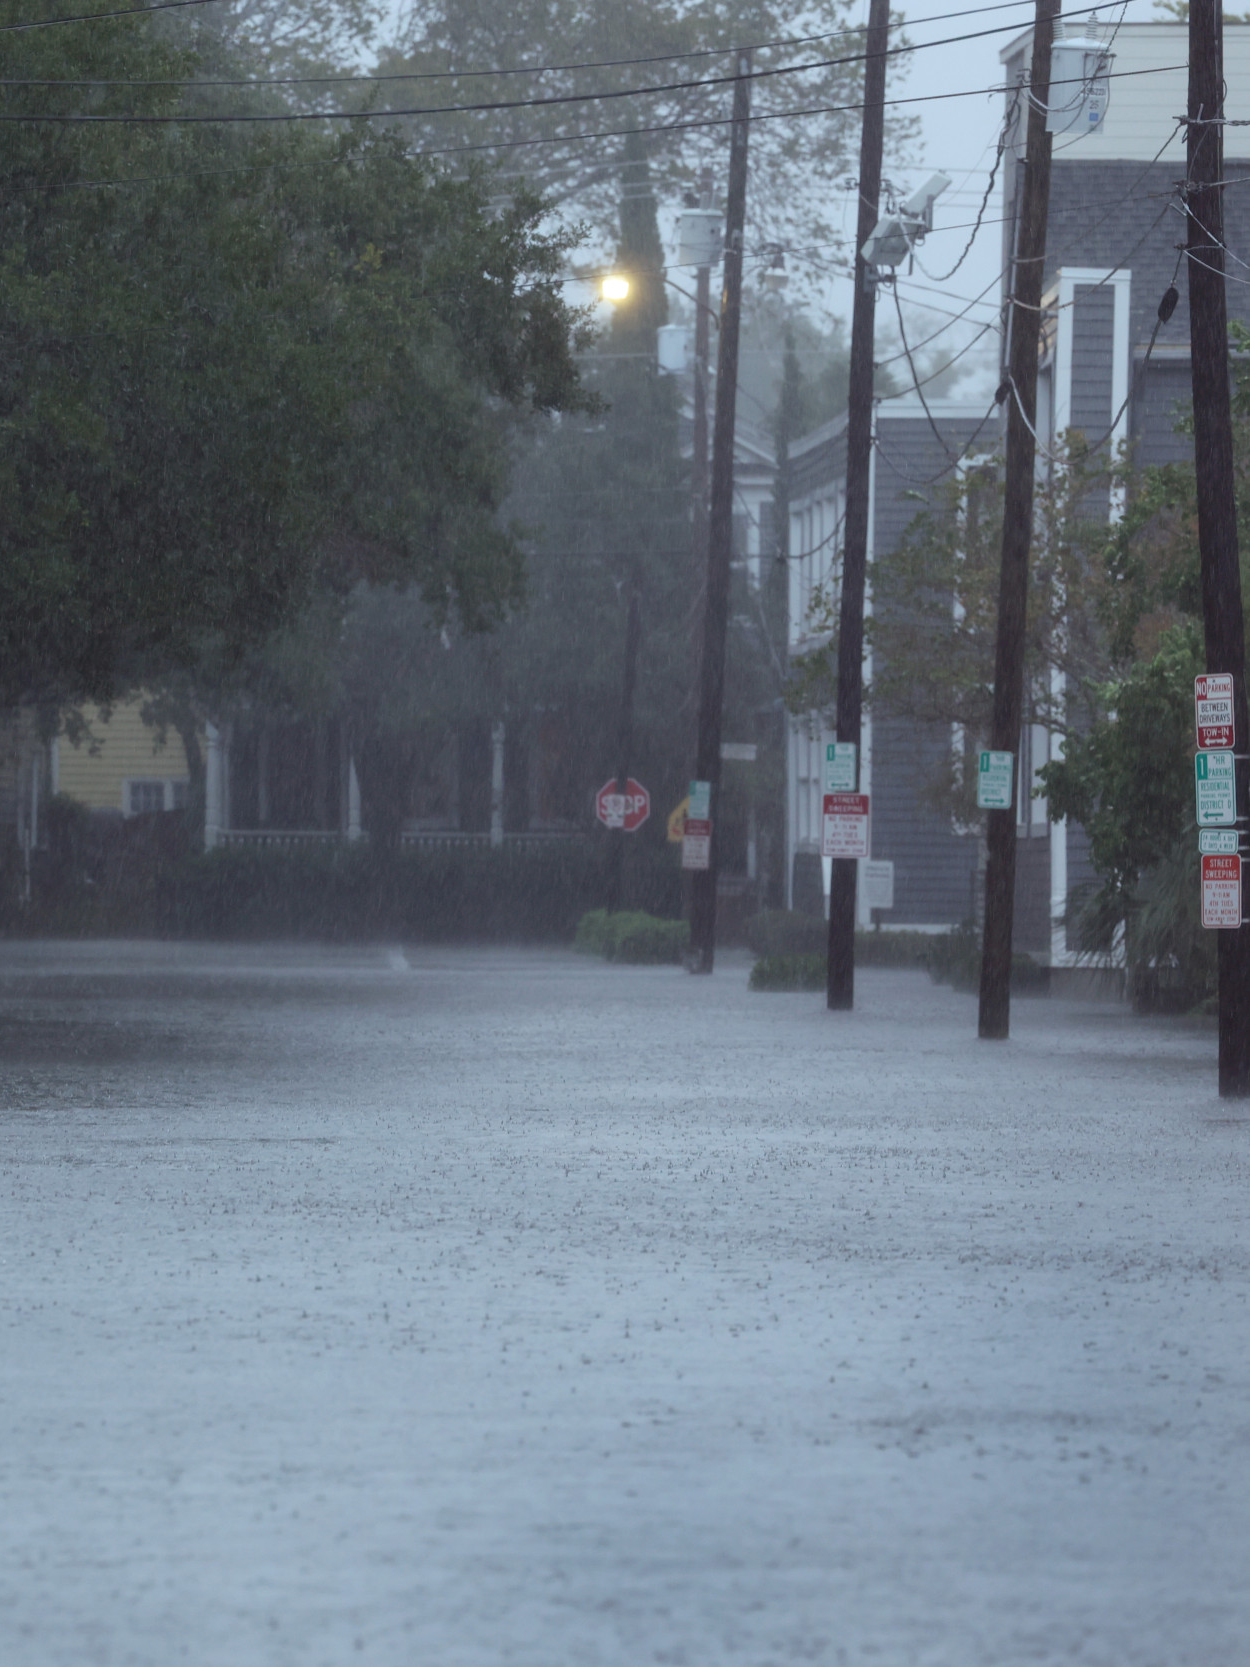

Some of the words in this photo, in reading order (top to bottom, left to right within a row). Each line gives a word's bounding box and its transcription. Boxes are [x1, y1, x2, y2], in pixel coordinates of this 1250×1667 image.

[1197, 682, 1206, 696] NO
[1208, 682, 1230, 692] PARKING
[1201, 702, 1228, 712] BETWEEN
[1200, 713, 1230, 724] DRIVEWAYS
[1203, 727, 1229, 737] TOW-IN
[1200, 758, 1204, 776] 1
[1216, 756, 1225, 764] HR
[1209, 768, 1231, 777] PARKING
[1201, 781, 1230, 792] RESIDENTIAL
[1201, 801, 1223, 810] DISTRICT
[1210, 859, 1232, 868] STREET
[1206, 870, 1237, 878] SWEEPING
